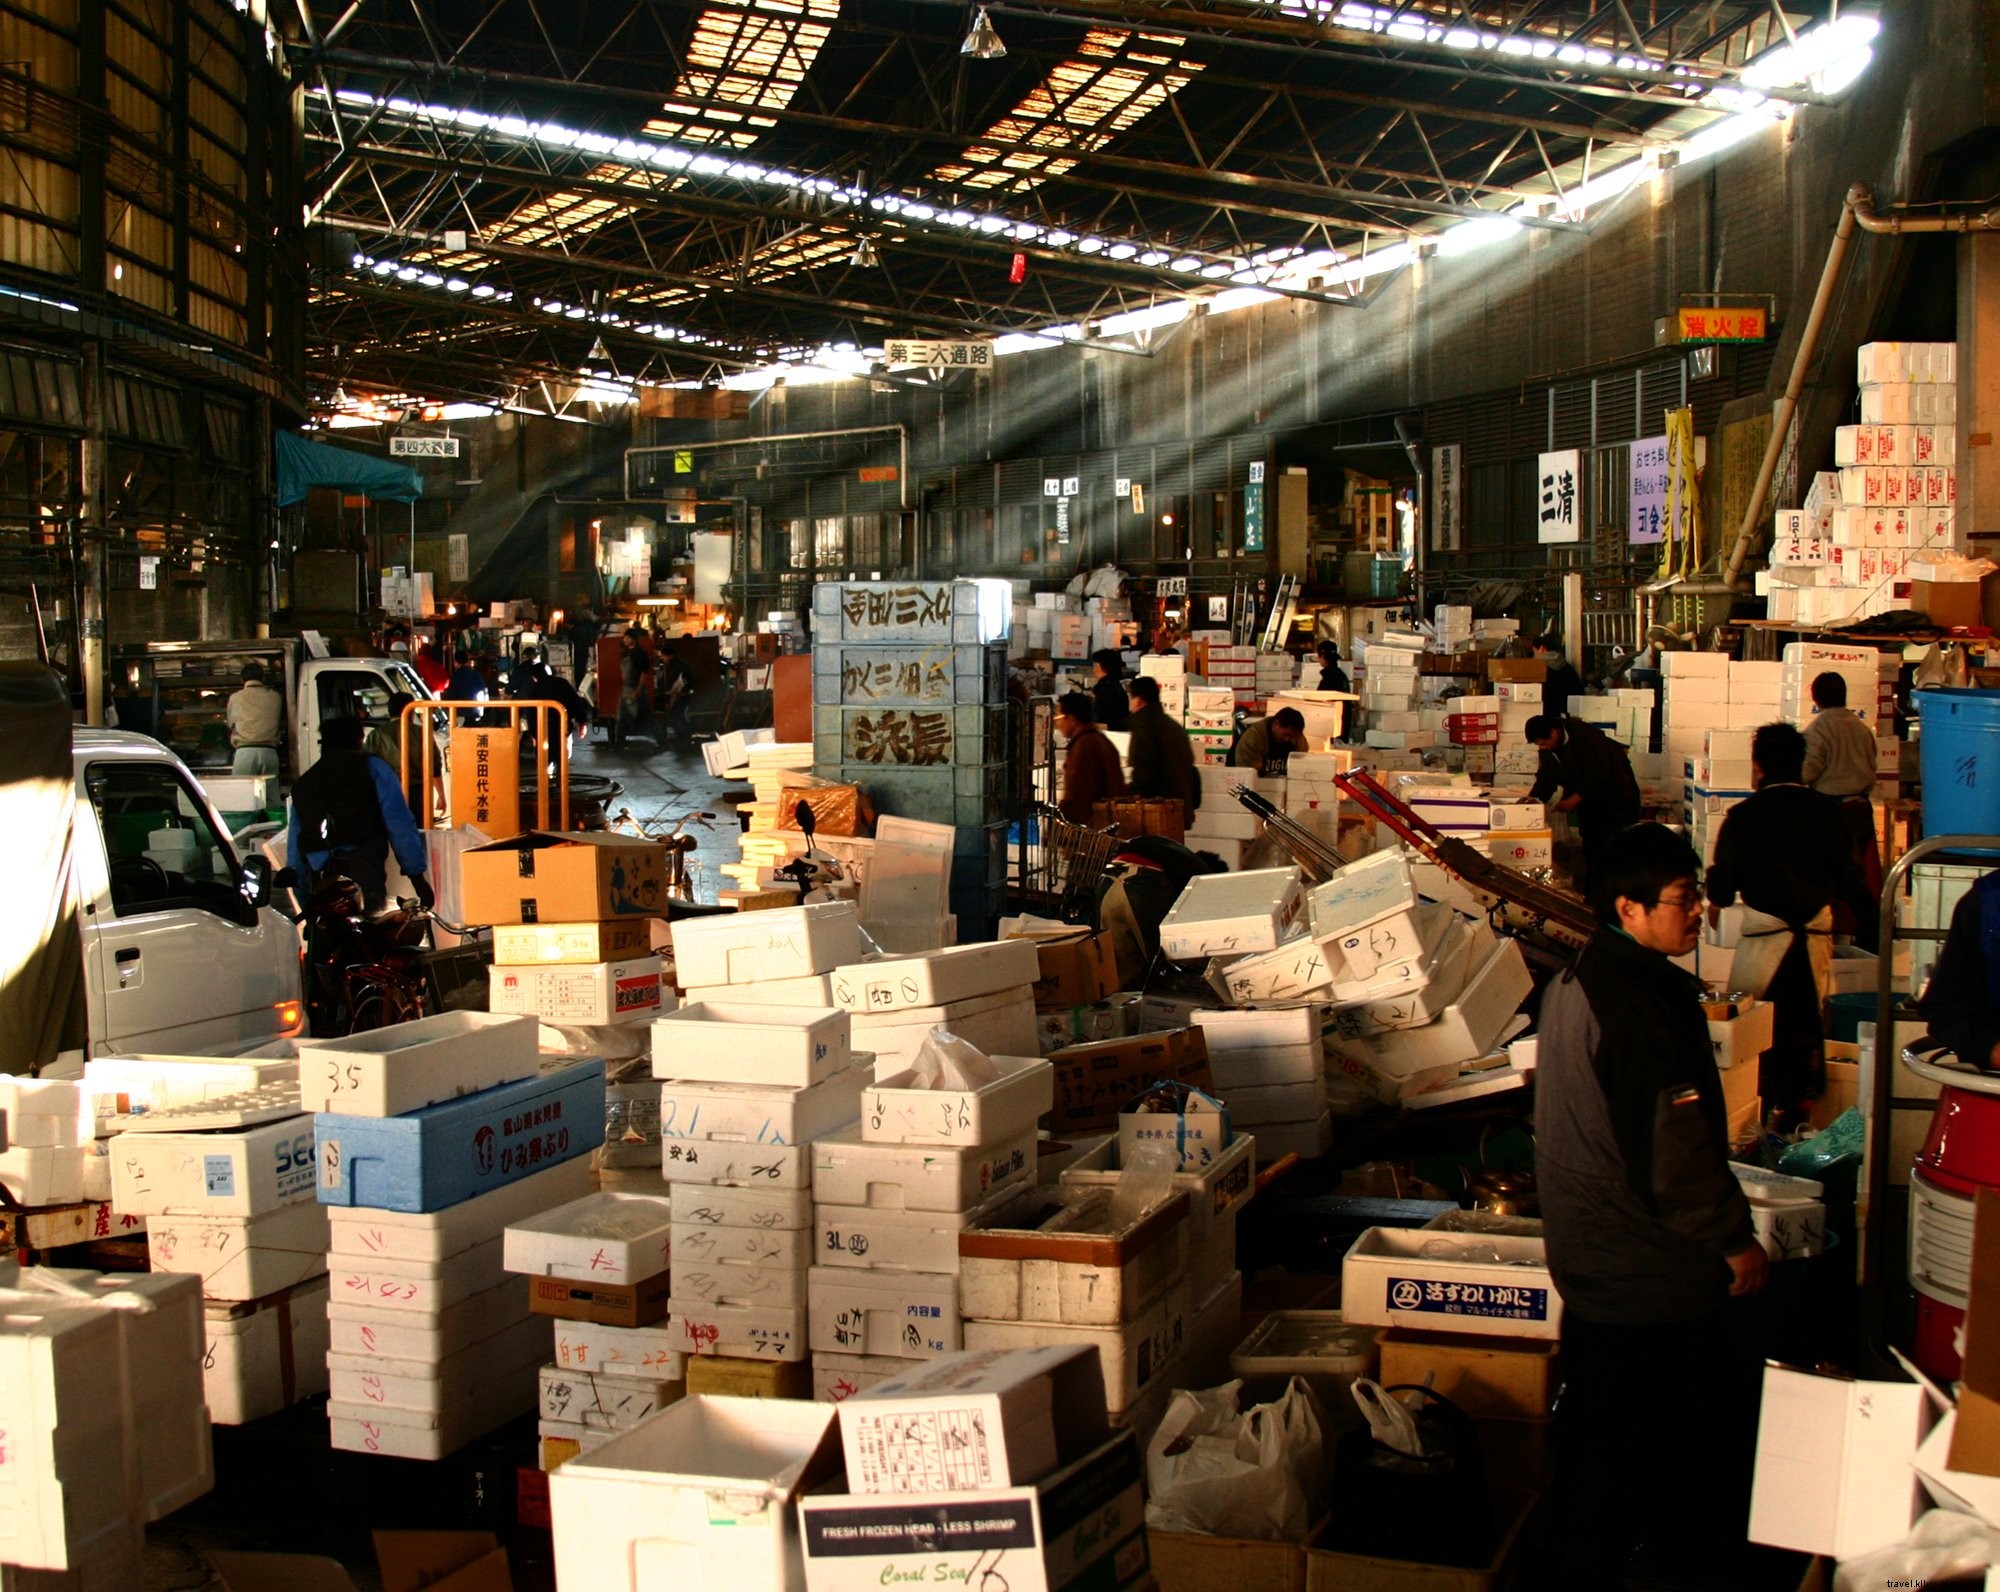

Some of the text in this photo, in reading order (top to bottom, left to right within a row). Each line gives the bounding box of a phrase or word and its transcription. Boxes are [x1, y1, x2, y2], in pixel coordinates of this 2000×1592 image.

[1685, 315, 1759, 338] 消火栓
[890, 343, 988, 365] 第三大通路
[1541, 470, 1575, 525] 三清
[476, 734, 489, 823] 浦安田代水産
[327, 1061, 363, 1094] 3.5
[500, 1126, 570, 1175] ひみ寒ぶり
[826, 1230, 846, 1250] 3L
[1425, 1281, 1533, 1308] 活ずわいがに
[906, 1304, 941, 1318] 内容量
[928, 1338, 944, 1351] kg
[822, 1525, 858, 1539] FRESH
[860, 1523, 903, 1538] FROZEN
[904, 1521, 936, 1536] HEAD
[943, 1520, 972, 1534] LESS
[974, 1518, 1017, 1532] SHRIMP
[879, 1562, 967, 1586] Coral Sea
